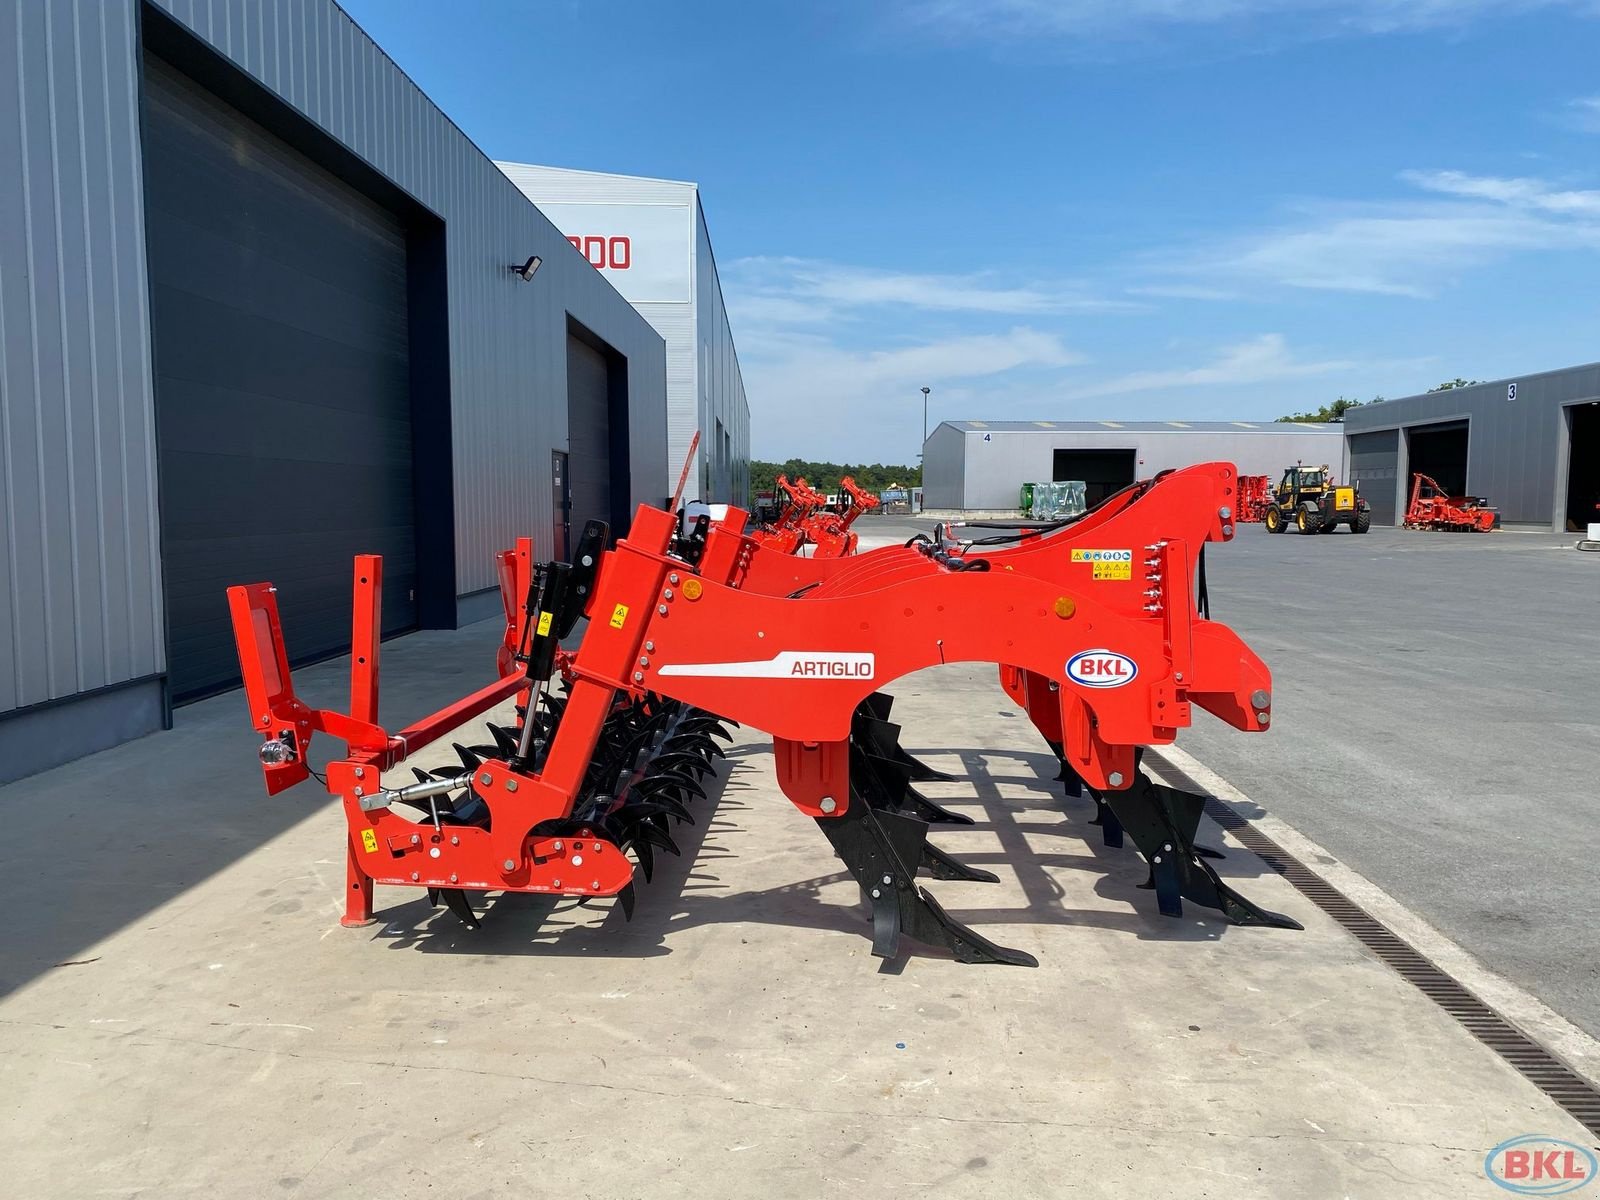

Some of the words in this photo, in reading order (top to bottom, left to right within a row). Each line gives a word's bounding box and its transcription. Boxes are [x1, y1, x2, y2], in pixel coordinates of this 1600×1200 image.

[1509, 384, 1516, 399] 3
[984, 433, 991, 442] 4
[791, 661, 871, 676] ARTIGLIO
[1080, 659, 1127, 676] BKL
